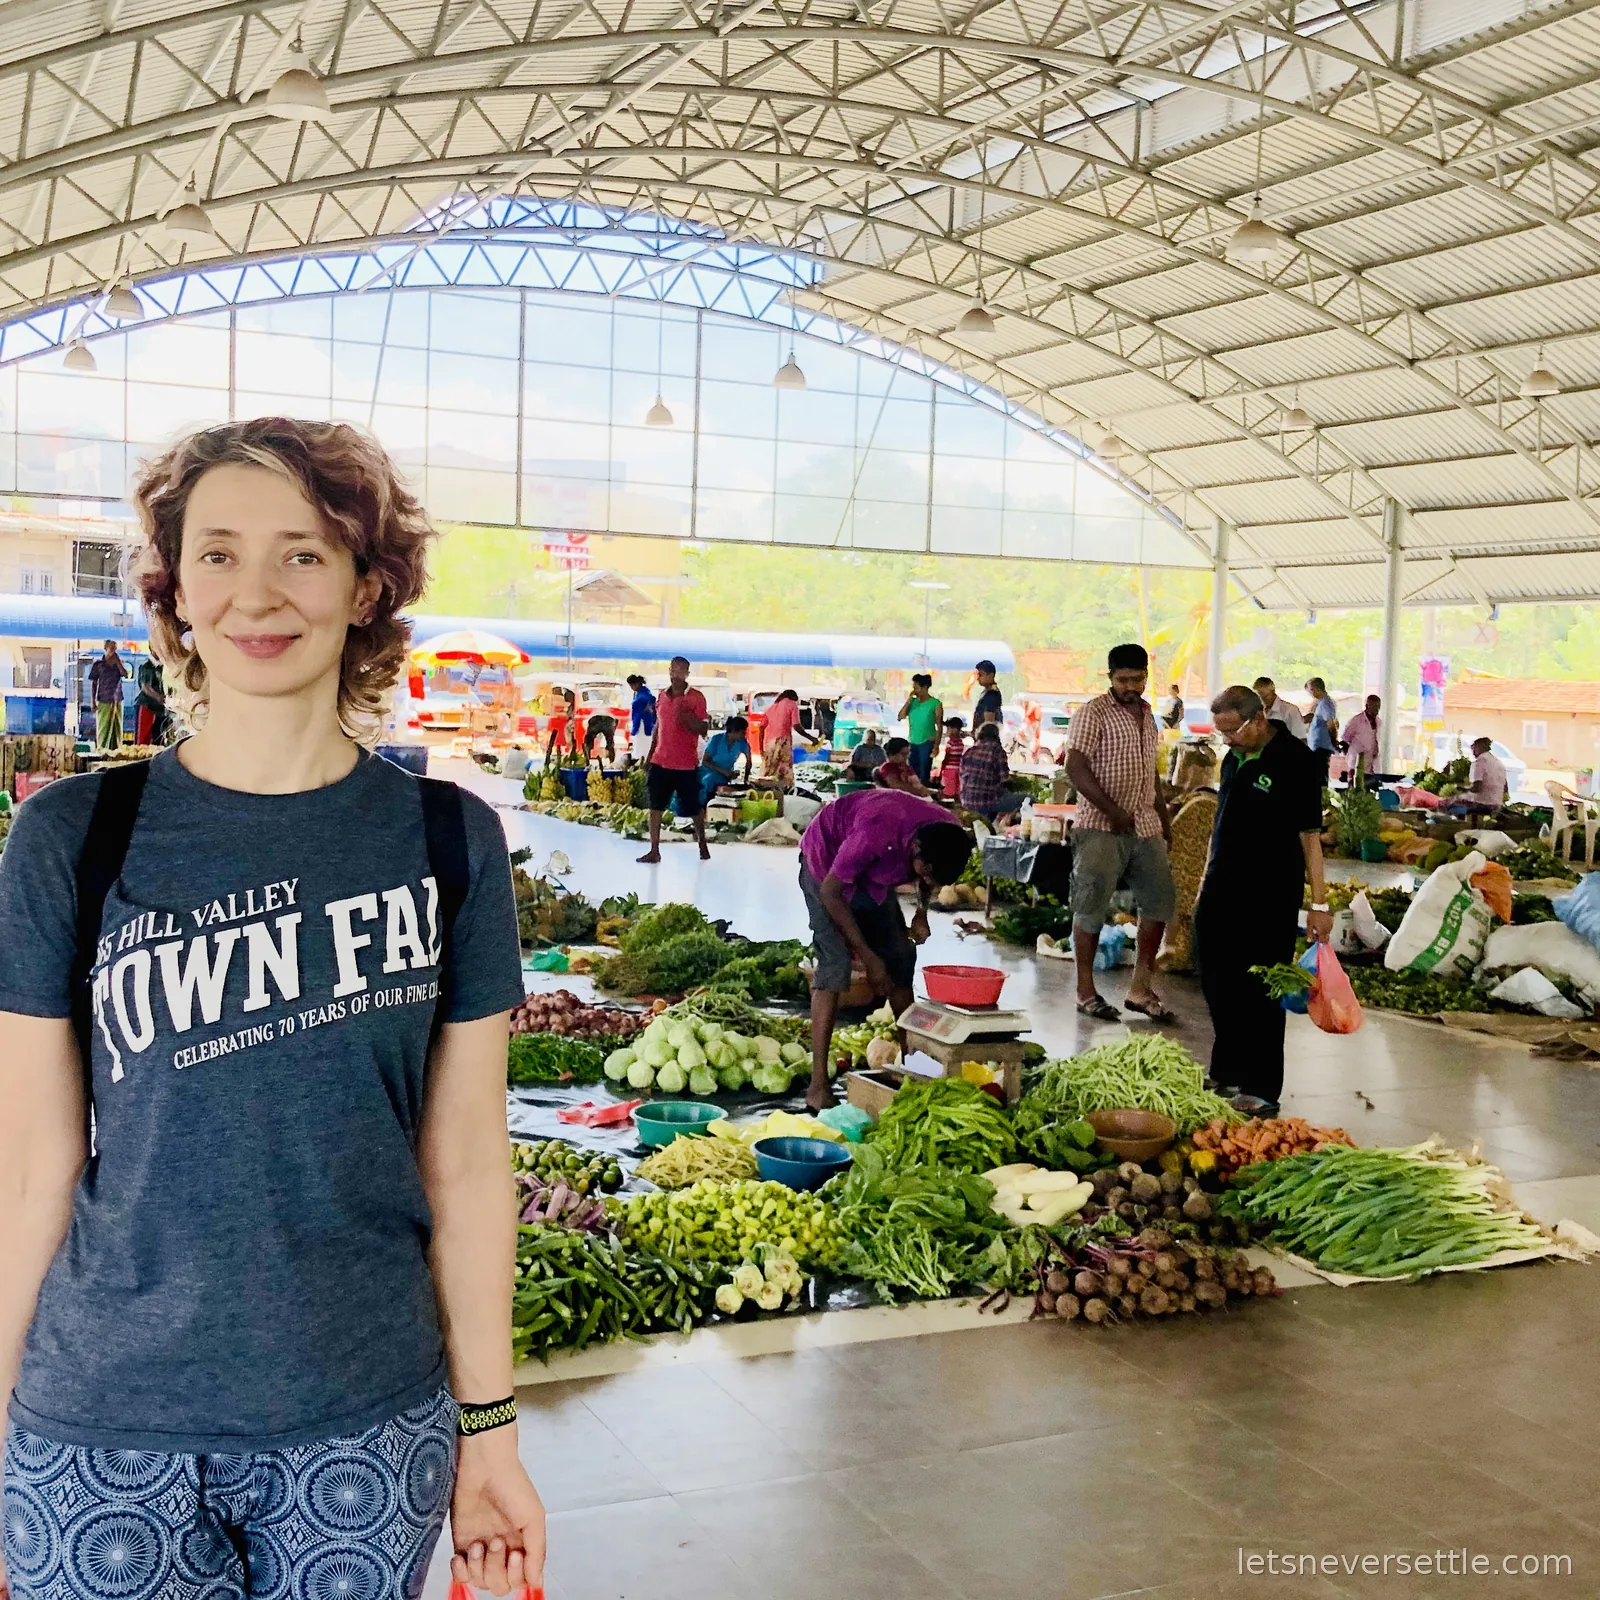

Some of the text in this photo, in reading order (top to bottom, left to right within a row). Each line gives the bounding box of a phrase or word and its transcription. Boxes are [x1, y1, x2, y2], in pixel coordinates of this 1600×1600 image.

[117, 911, 183, 953] HILL
[191, 877, 299, 929] VALLEY
[92, 911, 302, 1084] TOWN
[173, 1023, 274, 1070] CELEBRATING
[278, 1016, 295, 1037] 70
[298, 1001, 347, 1031] YEARS
[351, 996, 371, 1015] OF
[374, 987, 403, 1008] OUR
[406, 983, 427, 1005] FINE
